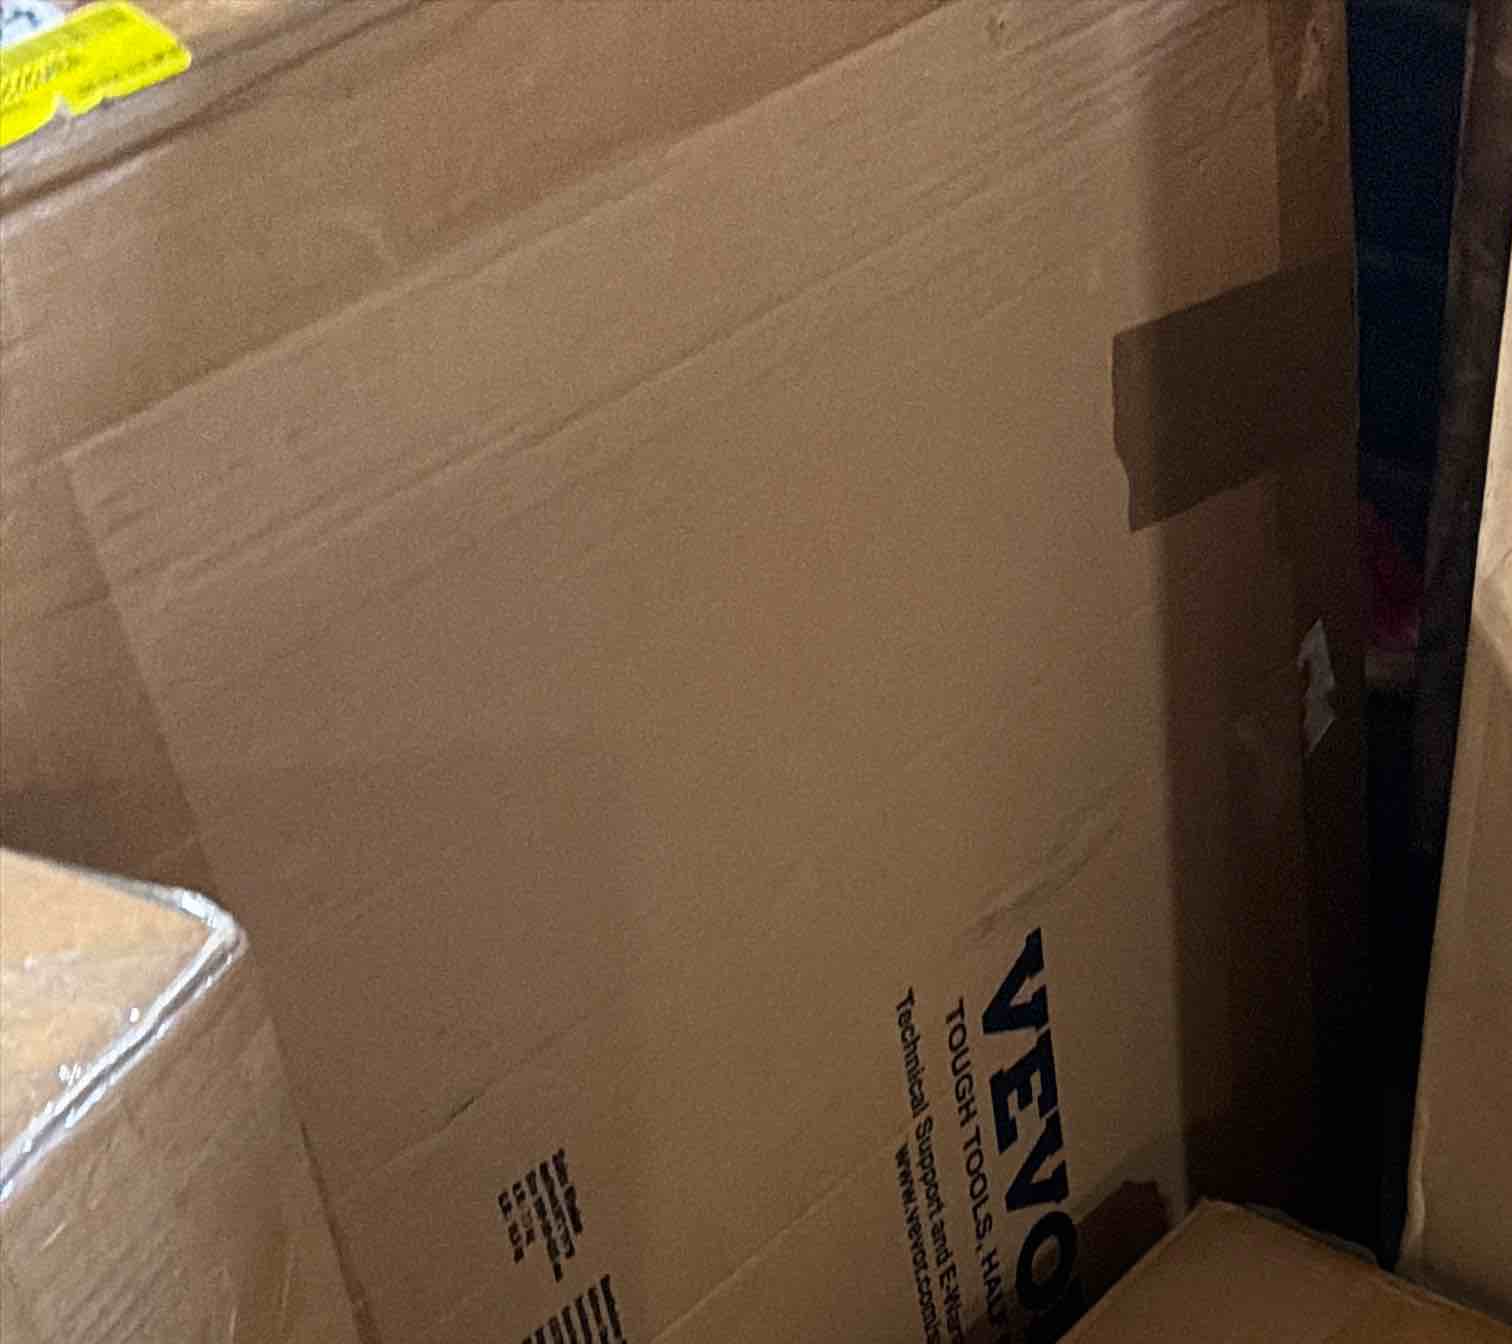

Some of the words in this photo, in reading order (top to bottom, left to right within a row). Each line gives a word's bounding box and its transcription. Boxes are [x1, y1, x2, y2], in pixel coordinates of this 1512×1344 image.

[896, 985, 924, 1119] Technical
[915, 1117, 944, 1219] Support
[930, 1218, 953, 1266] and
[944, 996, 978, 1129] TOUGH
[961, 1131, 994, 1255] TOOLS,
